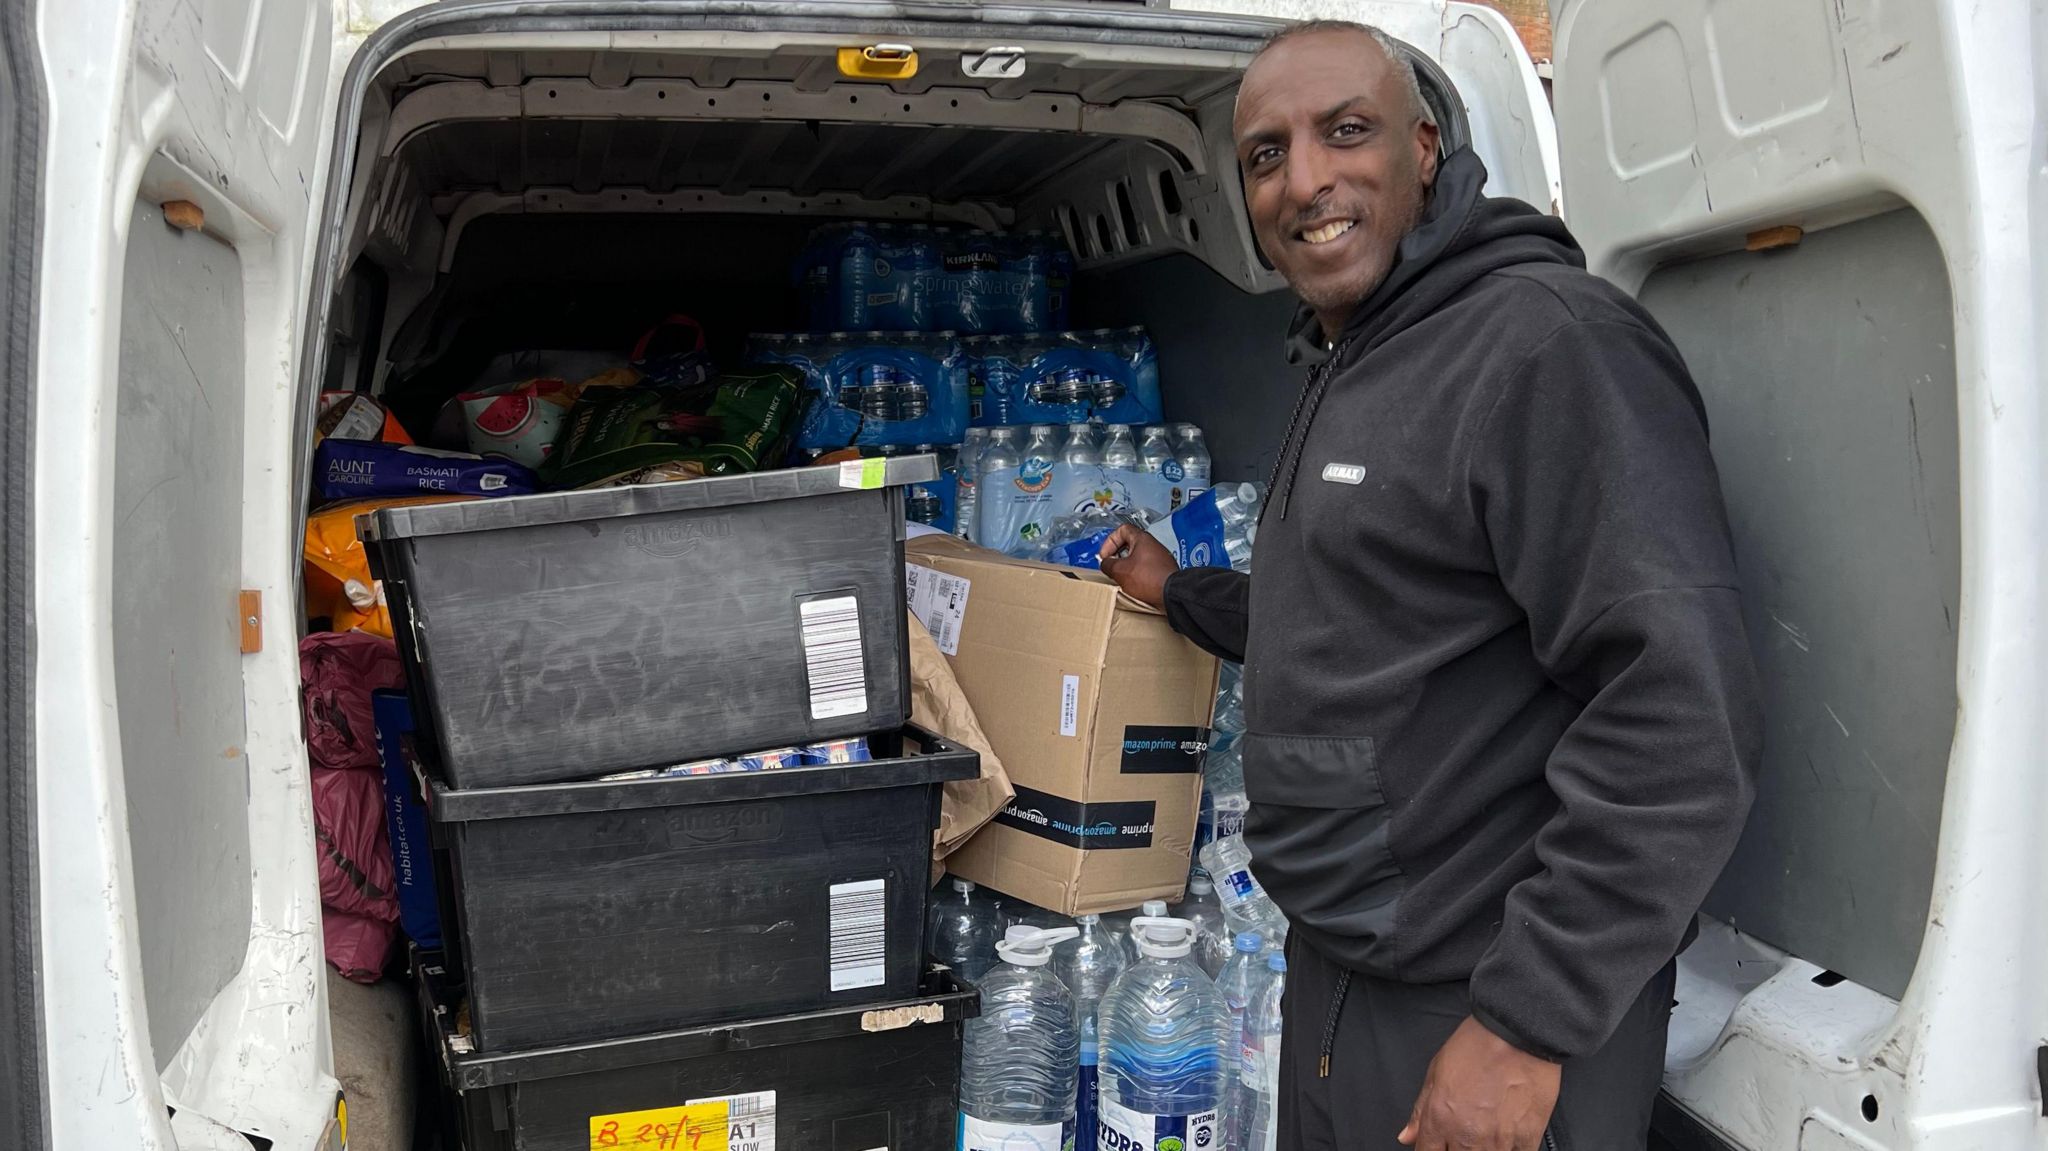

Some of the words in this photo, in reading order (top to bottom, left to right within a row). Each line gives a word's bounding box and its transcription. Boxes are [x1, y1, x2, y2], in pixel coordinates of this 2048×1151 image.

[328, 459, 376, 475] AUNT
[406, 465, 460, 479] BASMATI
[328, 474, 376, 487] CAROLINE
[418, 478, 446, 491] RICE
[393, 794, 413, 887] habitat.co.uk
[1191, 1112, 1215, 1126] HYDR8
[728, 1122, 757, 1141] A1
